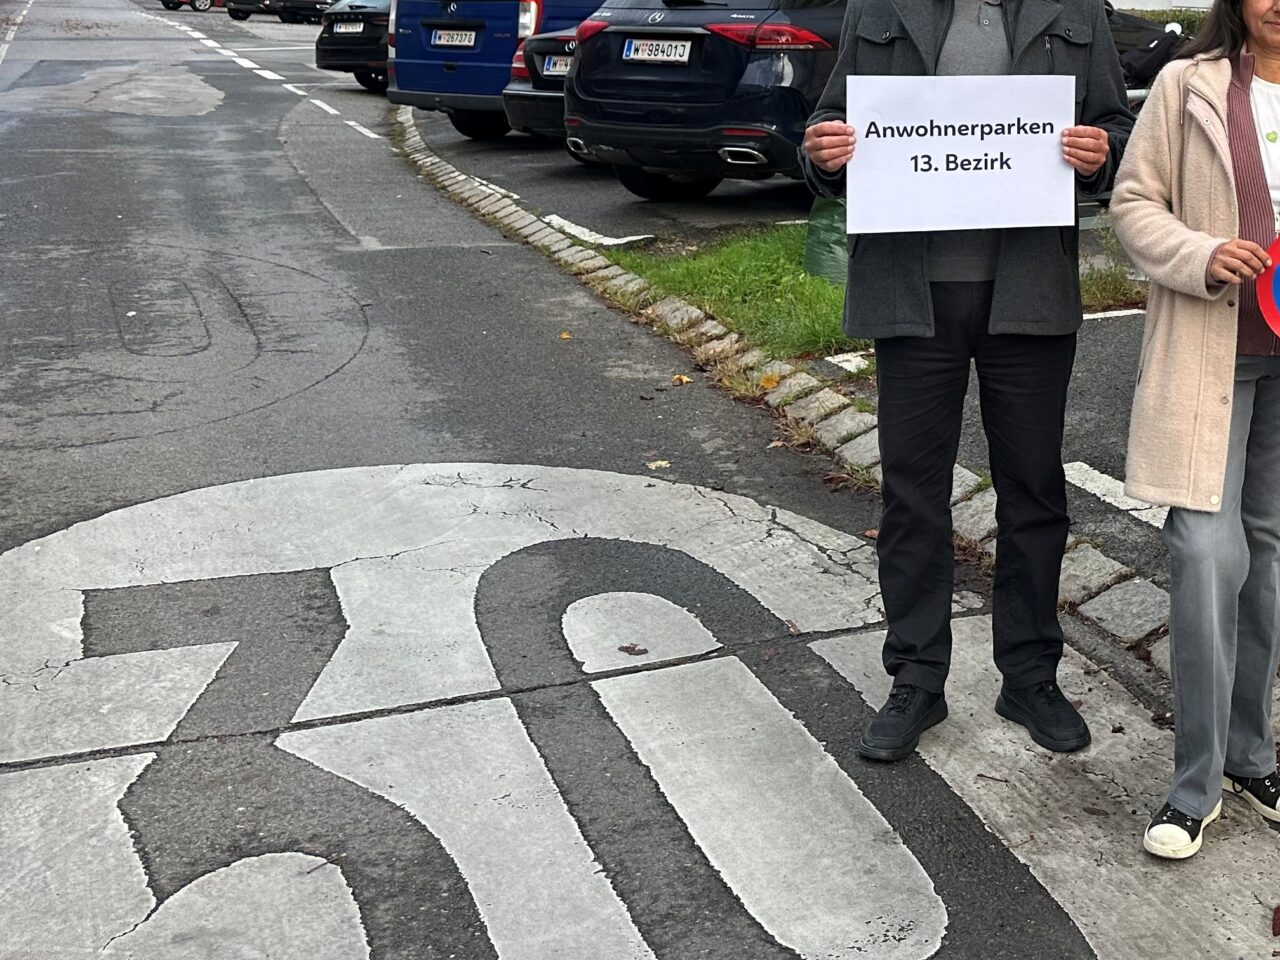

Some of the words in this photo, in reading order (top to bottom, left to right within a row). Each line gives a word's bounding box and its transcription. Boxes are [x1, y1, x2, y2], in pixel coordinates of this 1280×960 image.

[633, 41, 641, 57] W
[647, 43, 687, 58] 98401J
[865, 117, 1054, 141] Anwohnerparken
[910, 154, 939, 172] 13.
[945, 152, 1012, 172] Bezirk
